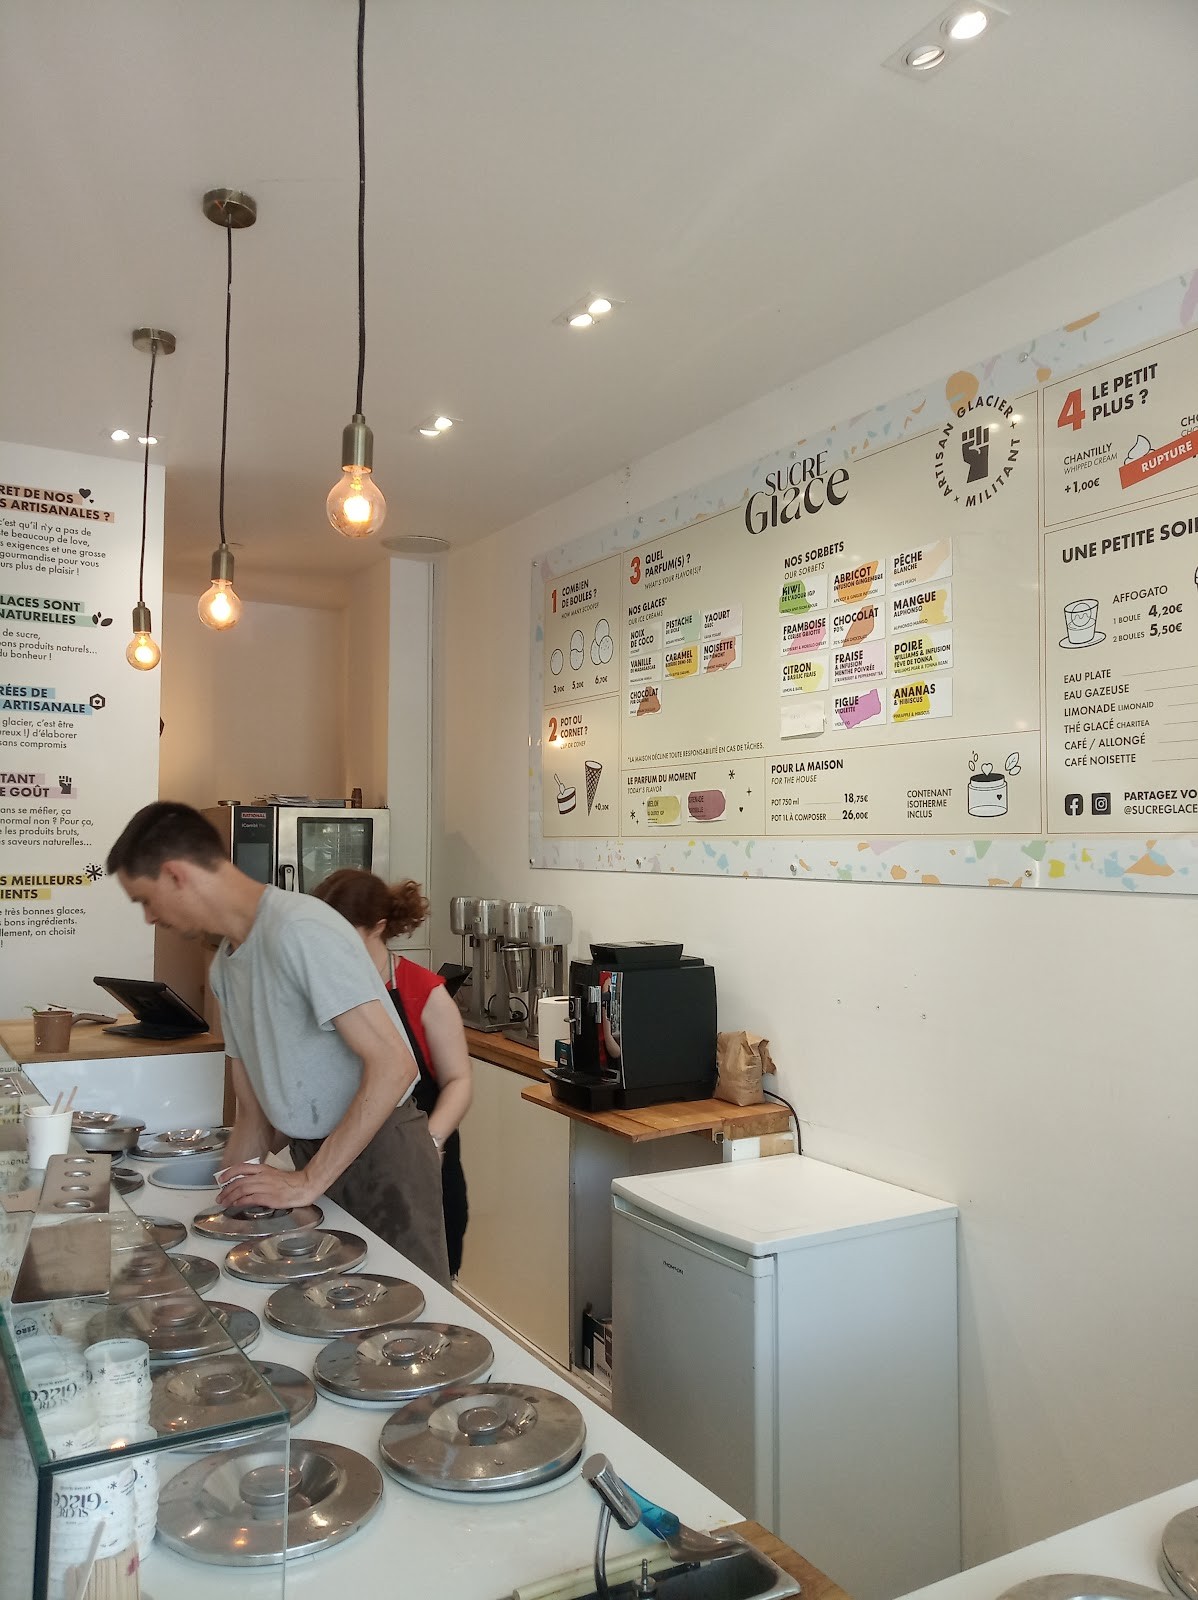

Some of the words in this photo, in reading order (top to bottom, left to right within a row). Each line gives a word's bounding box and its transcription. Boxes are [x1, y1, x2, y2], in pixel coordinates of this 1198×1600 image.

[1057, 388, 1086, 431] 4
[1093, 381, 1109, 400] LE
[1114, 363, 1158, 393] PETIT
[1093, 393, 1134, 421] PLUS
[1139, 389, 1149, 404] ?
[935, 422, 954, 497] ARTISAN
[957, 395, 1014, 419] GLACIER
[1063, 442, 1112, 466] CHANTILLY
[1141, 441, 1193, 473] RUPTURE
[1064, 460, 1093, 475] WHIPPED
[1094, 452, 1118, 466] CREAM
[765, 450, 828, 497] SUCRE
[966, 438, 1020, 507] MILITANT
[24, 488, 40, 499] DE
[44, 491, 74, 504] NOS
[745, 467, 850, 535] Glace
[11, 500, 100, 520] ARTISANALES
[12, 529, 55, 543] beaucoup
[57, 535, 68, 543] de
[71, 536, 90, 547] love,
[1062, 542, 1097, 563] UNE
[1102, 528, 1155, 555] PETITE
[0, 551, 56, 563] gourmandise
[58, 558, 78, 568] pour
[784, 554, 802, 569] NOS
[805, 541, 844, 562] SORBETS
[894, 551, 922, 568] PÊCHE
[15, 561, 33, 571] plus
[35, 563, 46, 572] de
[49, 565, 75, 575] plaisir
[629, 556, 641, 585] 3
[645, 549, 664, 565] QUEL
[645, 555, 685, 578] PARFUM(S)
[784, 570, 797, 580] OUR
[798, 562, 825, 576] SORBETS
[894, 563, 918, 575] BLANCHE
[834, 566, 872, 585] ABRICOT
[551, 589, 557, 613] 1
[562, 579, 589, 597] COMBIEN
[782, 583, 801, 596] KIWI
[1112, 585, 1168, 604] AFFOGATO
[0, 595, 39, 608] LACES
[43, 600, 80, 612] SONT
[561, 599, 569, 608] DE
[570, 590, 592, 605] BOULES
[894, 591, 936, 611] MANGUE
[628, 604, 641, 616] NOS
[704, 609, 731, 623] YAOURT
[833, 607, 879, 626] CHOCOLAT
[894, 605, 923, 617] ALPHONSO
[1119, 613, 1141, 624] BOULE
[1148, 603, 1183, 618] 4,20€
[666, 615, 692, 629] PISTACHE
[783, 617, 826, 635] FRAMBOISE
[630, 629, 645, 640] NOIX
[1119, 632, 1145, 642] BOULES
[1149, 623, 1183, 637] 5,50€
[19, 641, 54, 651] produits
[630, 639, 637, 648] DE
[638, 635, 654, 646] COCO
[704, 640, 733, 654] NOISETTE
[894, 639, 923, 654] POIRE
[11, 650, 47, 660] bonheur
[665, 649, 693, 662] CARAMEL
[835, 650, 863, 664] FRAISE
[630, 657, 652, 668] VANILLE
[783, 662, 812, 675] CITRON
[1063, 673, 1082, 684] EAU
[1084, 669, 1111, 681] PLATE
[31, 688, 47, 698] DE
[630, 687, 658, 700] CHOCOLAT
[894, 683, 936, 699] ANANAS
[1064, 689, 1082, 700] EAU
[1084, 684, 1129, 698] GAZEUSE
[3, 700, 85, 713] ARTISANALE
[835, 695, 859, 708] FIGUE
[900, 696, 923, 705] HIBISCUS
[1064, 703, 1115, 717] LIMONADE
[1118, 701, 1154, 711] LIMONAID
[2, 717, 34, 727] glacier,
[58, 720, 74, 728] être
[548, 717, 557, 742] 2
[561, 716, 572, 726] POT
[573, 715, 582, 724] OU
[1064, 721, 1081, 733] THÉ
[1083, 718, 1114, 732] GLACÉ
[1116, 719, 1150, 729] CHARITEA
[561, 726, 583, 738] CORNET
[20, 741, 67, 749] compromis
[1064, 738, 1087, 750] CAFÉ
[1089, 738, 1096, 750] /
[1098, 733, 1146, 748] ALLONGÉ
[771, 762, 793, 774] POUR
[795, 763, 805, 773] LA
[807, 759, 844, 772] MAISON
[1064, 754, 1088, 767] CAFÉ
[1090, 753, 1136, 766] NOISETTE
[0, 773, 35, 784] TANT
[627, 777, 633, 785] LE
[634, 775, 657, 784] PARFUM
[658, 774, 667, 783] DU
[668, 771, 697, 782] MOMENT
[771, 777, 782, 785] FOR
[784, 776, 794, 784] THE
[796, 775, 817, 783] HOUSE
[10, 785, 49, 797] GOÛT
[907, 789, 952, 798] CONTENANT
[1124, 789, 1177, 801] PARTAGEZ
[844, 793, 868, 804] 18,75€
[907, 799, 947, 808] ISOTHERME
[795, 813, 826, 821] COMPOSER
[842, 810, 868, 820] 26,00€
[907, 810, 933, 819] INCLUS
[1124, 804, 1198, 815] @SUCREGLACE
[5, 826, 17, 835] les
[19, 827, 54, 837] produits
[56, 827, 80, 836] bruts,
[11, 875, 83, 886] MEILLEURS
[0, 889, 38, 899] IENTS
[5, 907, 20, 916] très
[23, 907, 54, 916] bonnes
[56, 906, 86, 916] glaces,
[4, 918, 26, 926] bons
[27, 917, 77, 927] ingrédients.
